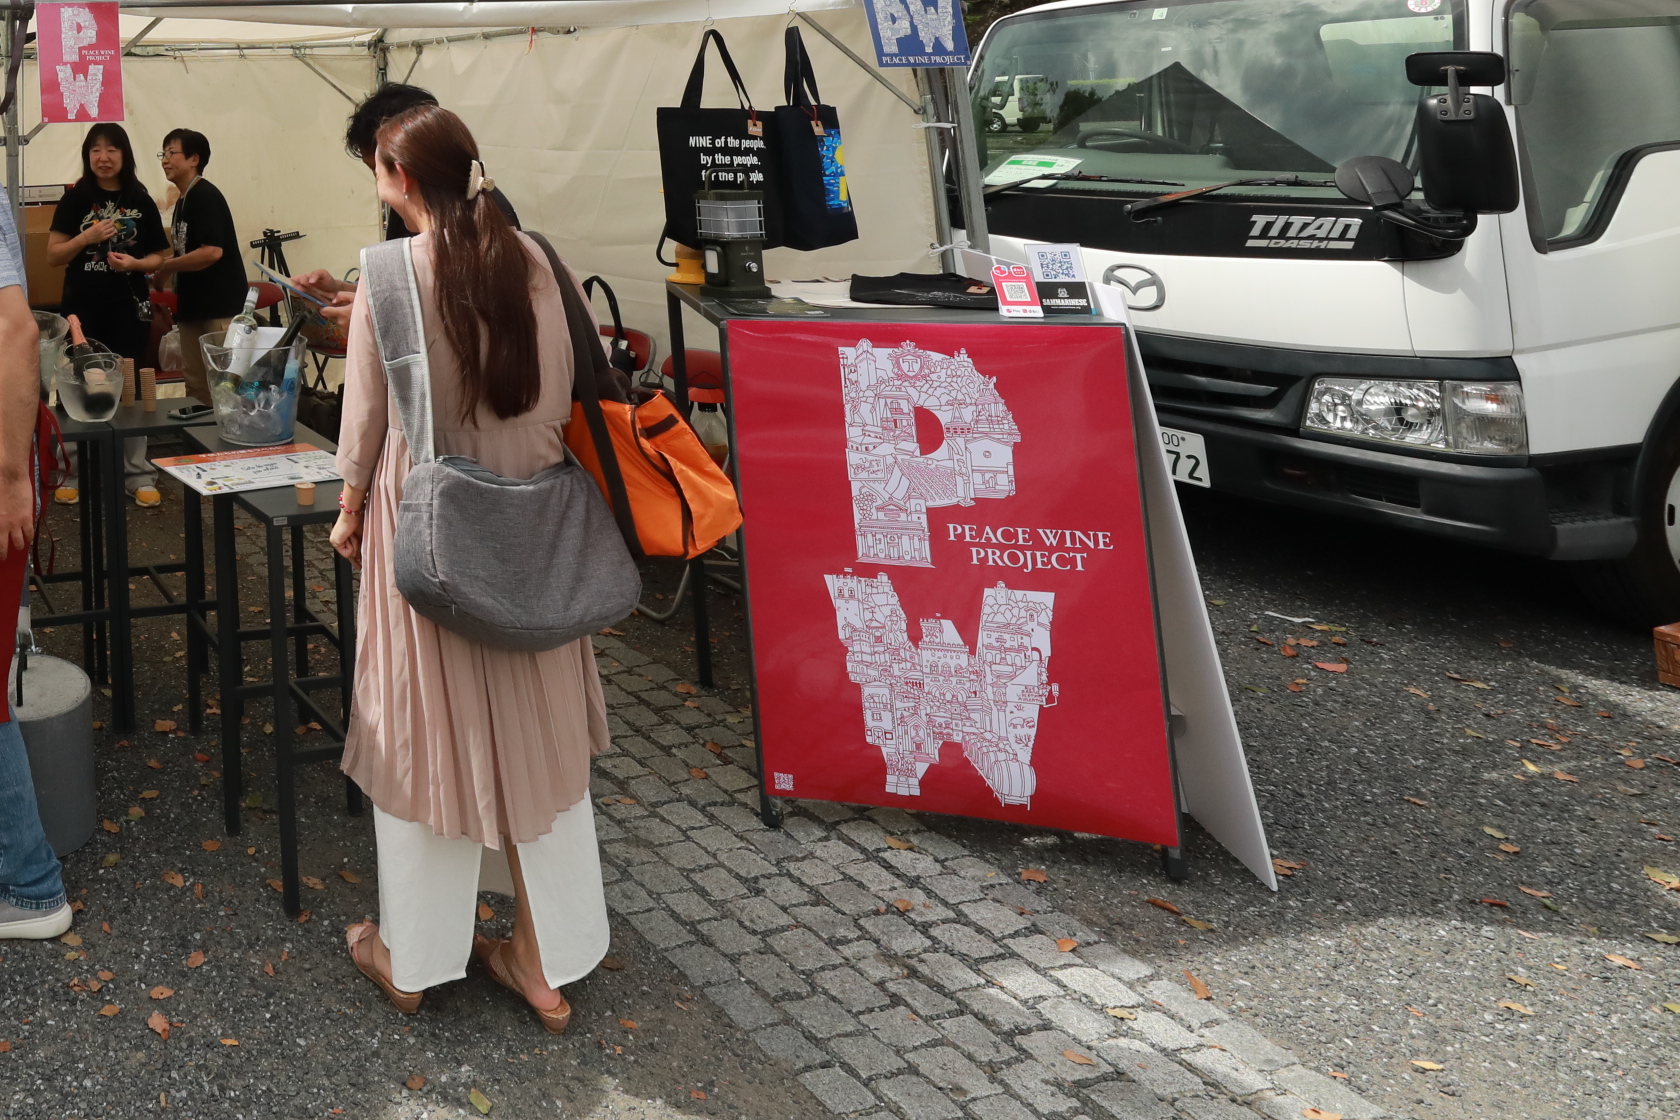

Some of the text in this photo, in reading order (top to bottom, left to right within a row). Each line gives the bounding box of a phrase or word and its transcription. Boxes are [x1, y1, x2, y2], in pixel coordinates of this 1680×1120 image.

[882, 55, 965, 64] PEACE WINE PROJECT
[689, 136, 713, 148] WINE
[715, 136, 725, 148] of
[727, 136, 740, 148] the
[700, 153, 712, 167] by
[715, 153, 731, 165] the
[701, 170, 716, 181] fr
[718, 172, 734, 181] the
[1248, 214, 1363, 239] TITAN
[1268, 239, 1329, 249] DASH
[1042, 298, 1088, 306] SAMMARINESE
[1166, 449, 1203, 482] 72
[947, 523, 1114, 550] PEACE WINE
[970, 547, 1087, 572] PROJECT
